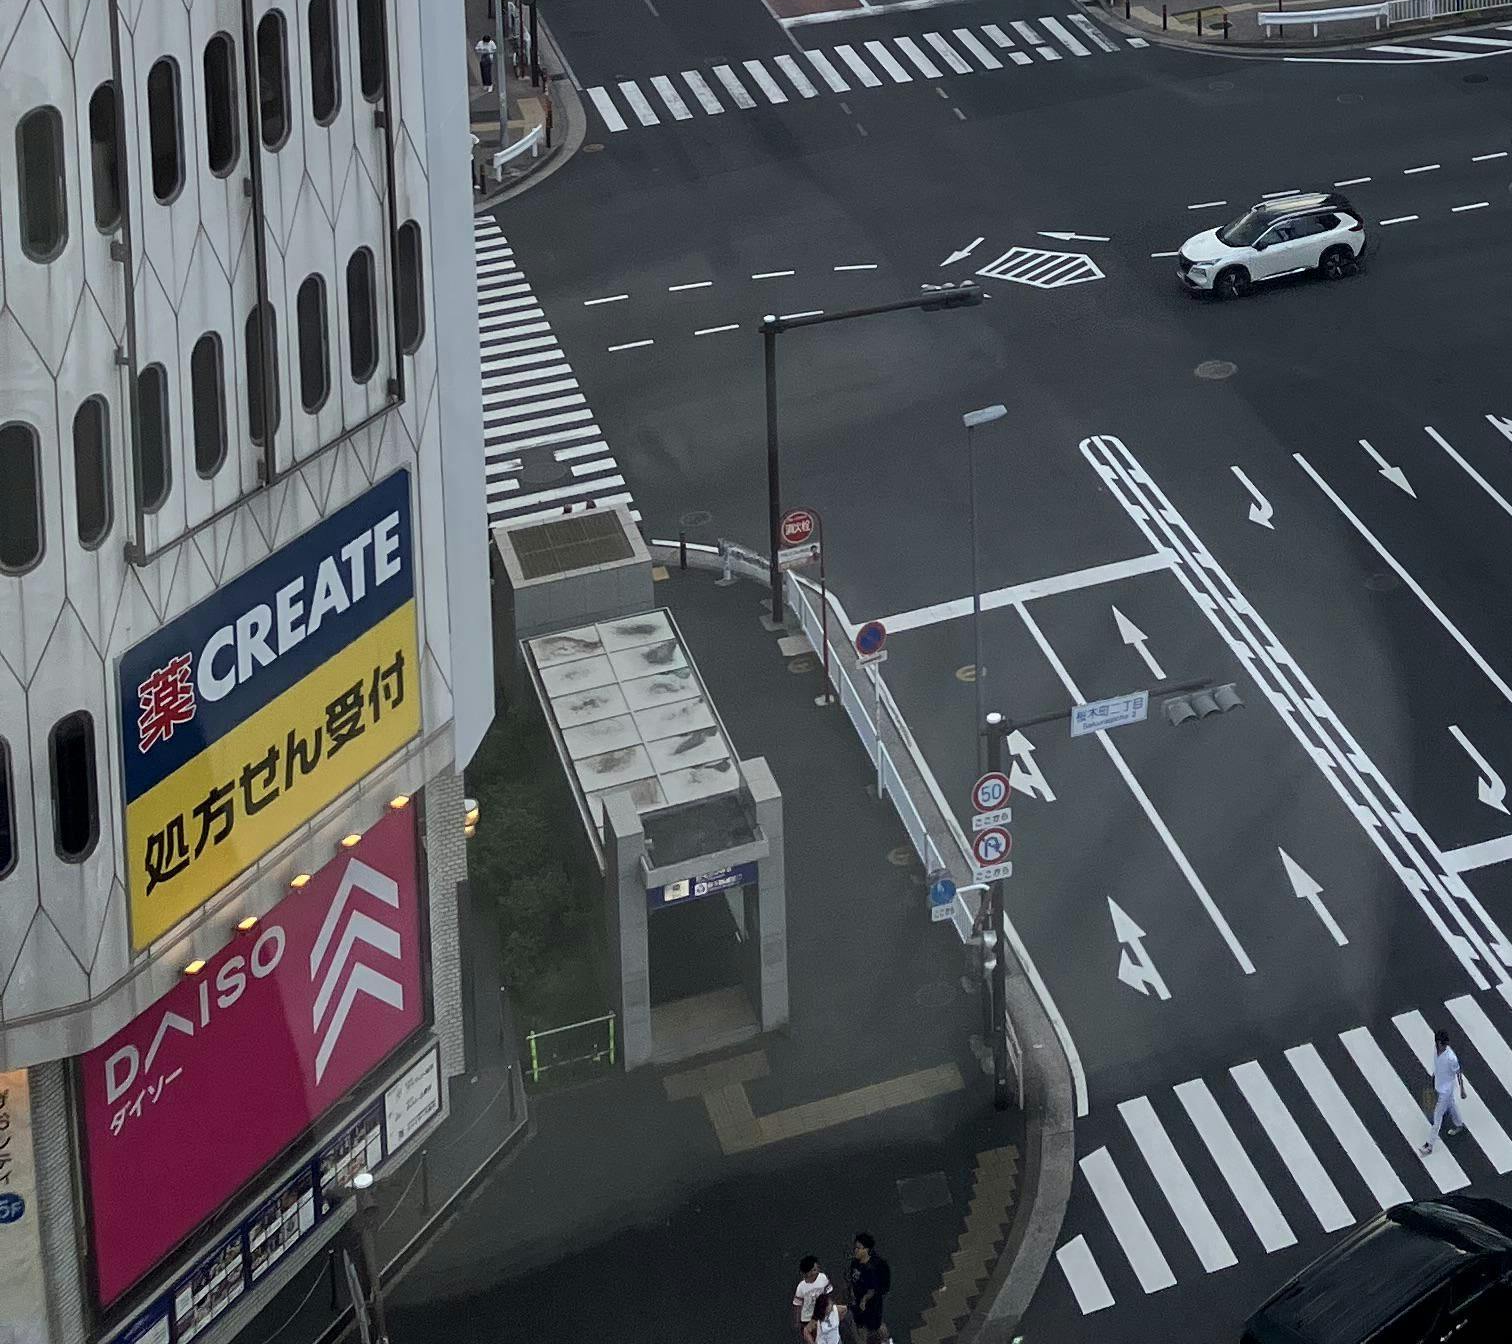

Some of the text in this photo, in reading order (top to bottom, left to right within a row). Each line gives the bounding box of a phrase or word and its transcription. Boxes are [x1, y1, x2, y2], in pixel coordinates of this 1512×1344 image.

[137, 509, 402, 754] 薬 CREATE
[145, 649, 407, 898] 処方せん受付
[981, 783, 1002, 803] 50
[975, 812, 1009, 827] ここから
[976, 866, 1010, 881] ここから
[105, 924, 288, 1106] DAISO
[109, 1066, 184, 1136] ダイソー
